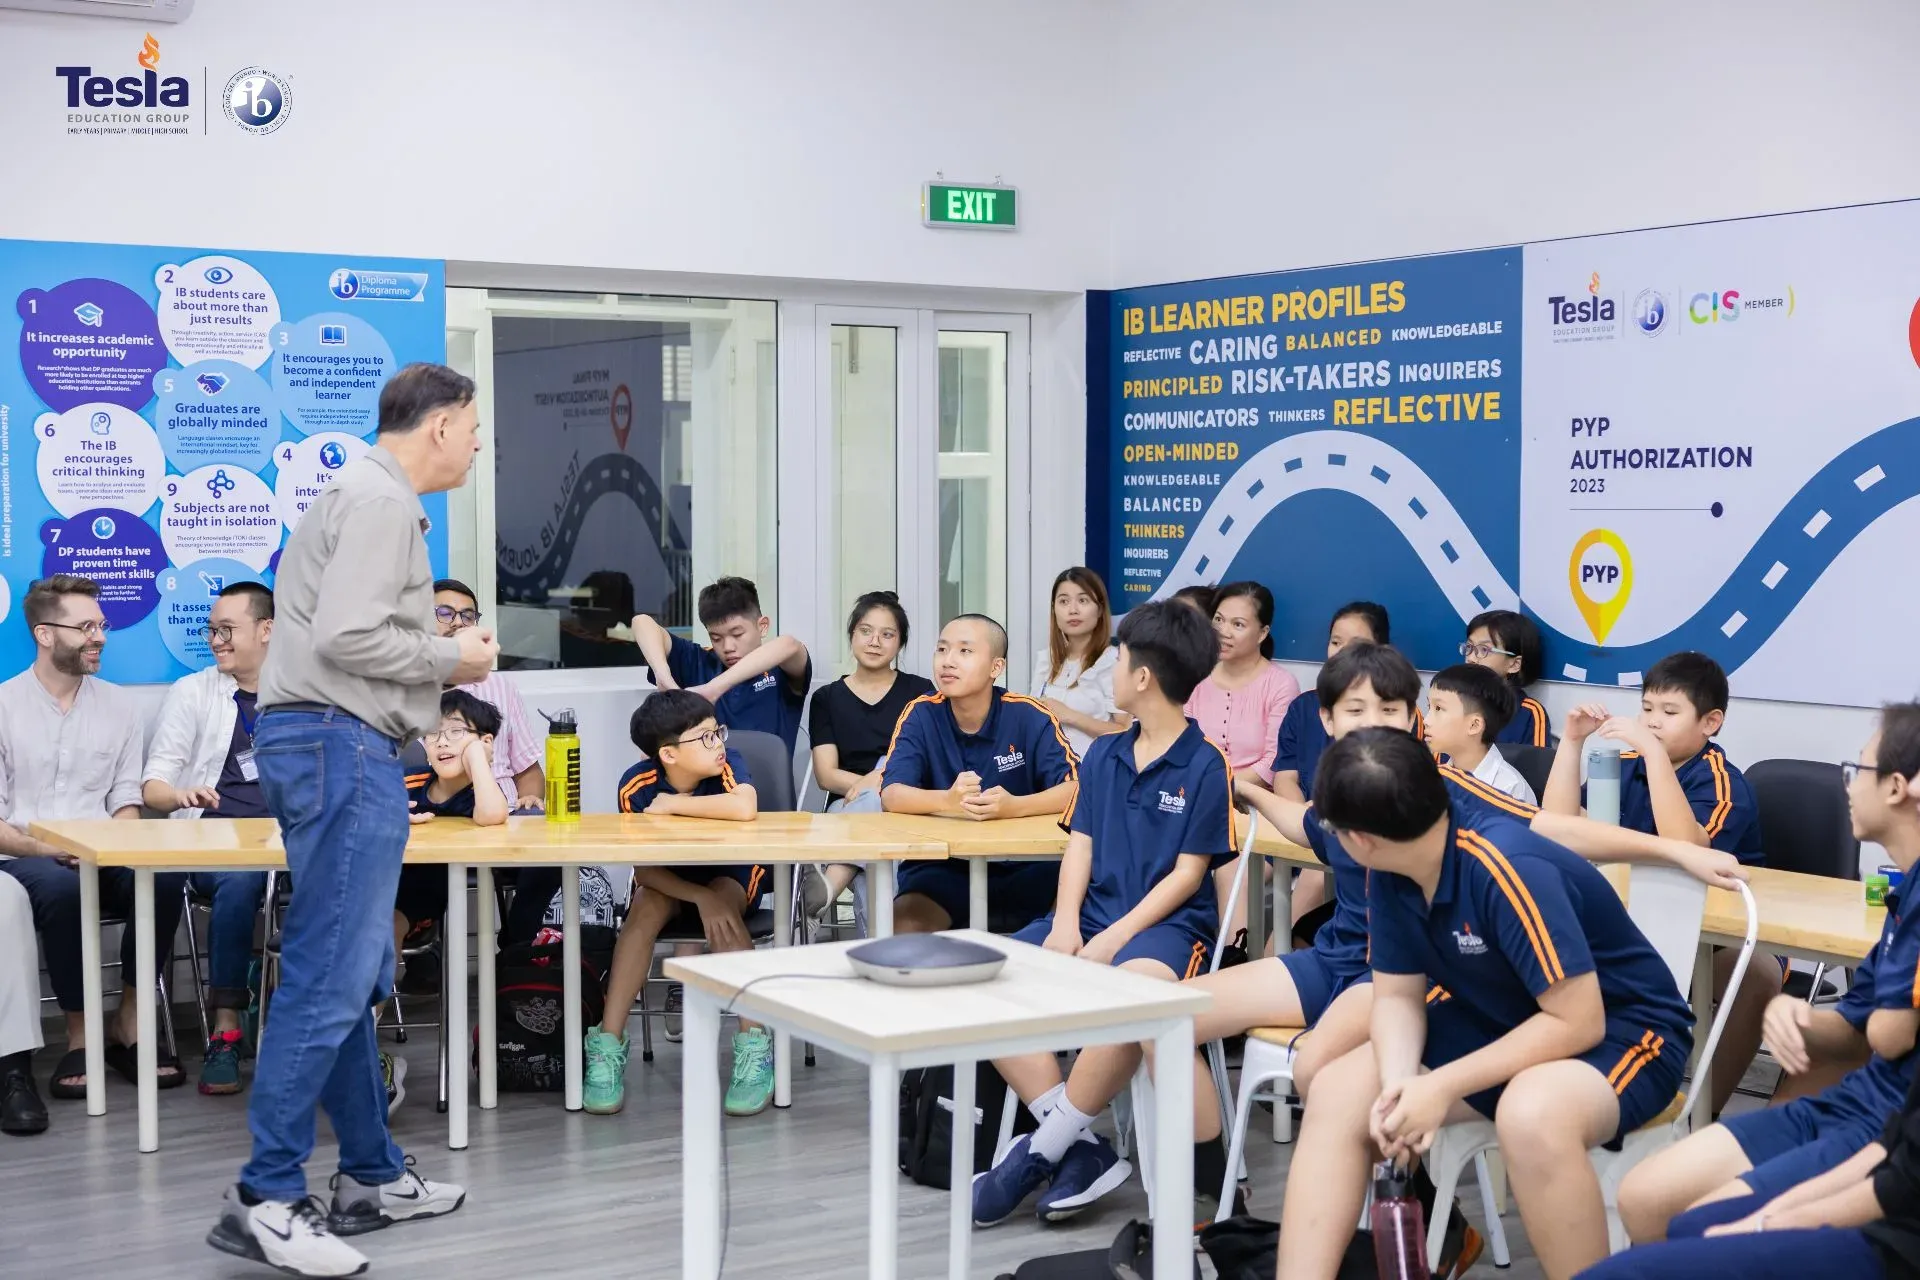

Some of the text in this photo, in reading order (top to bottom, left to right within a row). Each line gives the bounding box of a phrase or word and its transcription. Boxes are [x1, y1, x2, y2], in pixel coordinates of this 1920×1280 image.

[948, 189, 997, 221] EXIT
[164, 269, 174, 283] 2
[361, 275, 397, 285] Diploma
[175, 287, 266, 300] IB students care
[361, 285, 411, 296] Programme
[28, 299, 37, 313] 1
[173, 300, 268, 313] about more than
[1123, 280, 1405, 336] IB LEARNER PROFILES
[1548, 295, 1615, 324] Tesla
[1689, 290, 1741, 325] CIS
[1744, 298, 1784, 310] MEMBER
[190, 313, 253, 326] just results
[1553, 325, 1615, 336] EDUCATION GROUP
[26, 332, 154, 346] It increases academic
[279, 332, 289, 346] 3
[1123, 320, 1502, 365] REFLECTIVE CARING BALANCED KNOWLEDGEABLE
[52, 347, 127, 360] opportunity
[283, 353, 384, 367] It encourages you to
[59, 371, 74, 379] likely
[127, 373, 145, 381] higher
[283, 365, 381, 377] become a confident
[164, 378, 174, 392] 5
[289, 378, 376, 390] and independent
[1123, 359, 1502, 398] PRINCIPLED RISK-TAKERS INQUIRERS
[315, 390, 352, 400] learner
[175, 402, 261, 414] Graduates are
[1123, 391, 1500, 431] COMMUNICATORS THINKERS REFLECTIVE
[44, 423, 56, 437] 6
[168, 416, 268, 430] globally minded
[1570, 417, 1611, 438] PYP
[81, 440, 117, 451] The IB
[1123, 442, 1239, 463] OPEN-MINDED
[64, 455, 133, 466] encourages
[282, 448, 293, 462] 4
[1570, 446, 1753, 470] AUTHORIZATION
[52, 466, 145, 479] critical thinking
[1123, 473, 1221, 486] KNOWLEDGEABLE
[0, 404, 11, 557] is ideal preparation for university
[1570, 478, 1605, 493] 2023
[167, 483, 177, 497] 9
[173, 502, 270, 515] Subjects are not
[1123, 497, 1202, 512] BALANCED
[167, 516, 277, 529] taught in isolation
[50, 528, 62, 543] 7
[1124, 524, 1185, 538] THINKERS
[58, 546, 151, 557] DP students have
[1123, 548, 1169, 559] INQUIRERS
[72, 558, 138, 570] proven time
[55, 568, 155, 580] anagement skills
[1123, 568, 1161, 577] REFLECTIVE
[1582, 564, 1619, 583] PYP
[166, 577, 177, 591] 8
[1123, 583, 1152, 592] CARING
[172, 603, 212, 612] It asses
[168, 615, 193, 625] than
[993, 751, 1024, 766] Tesla
